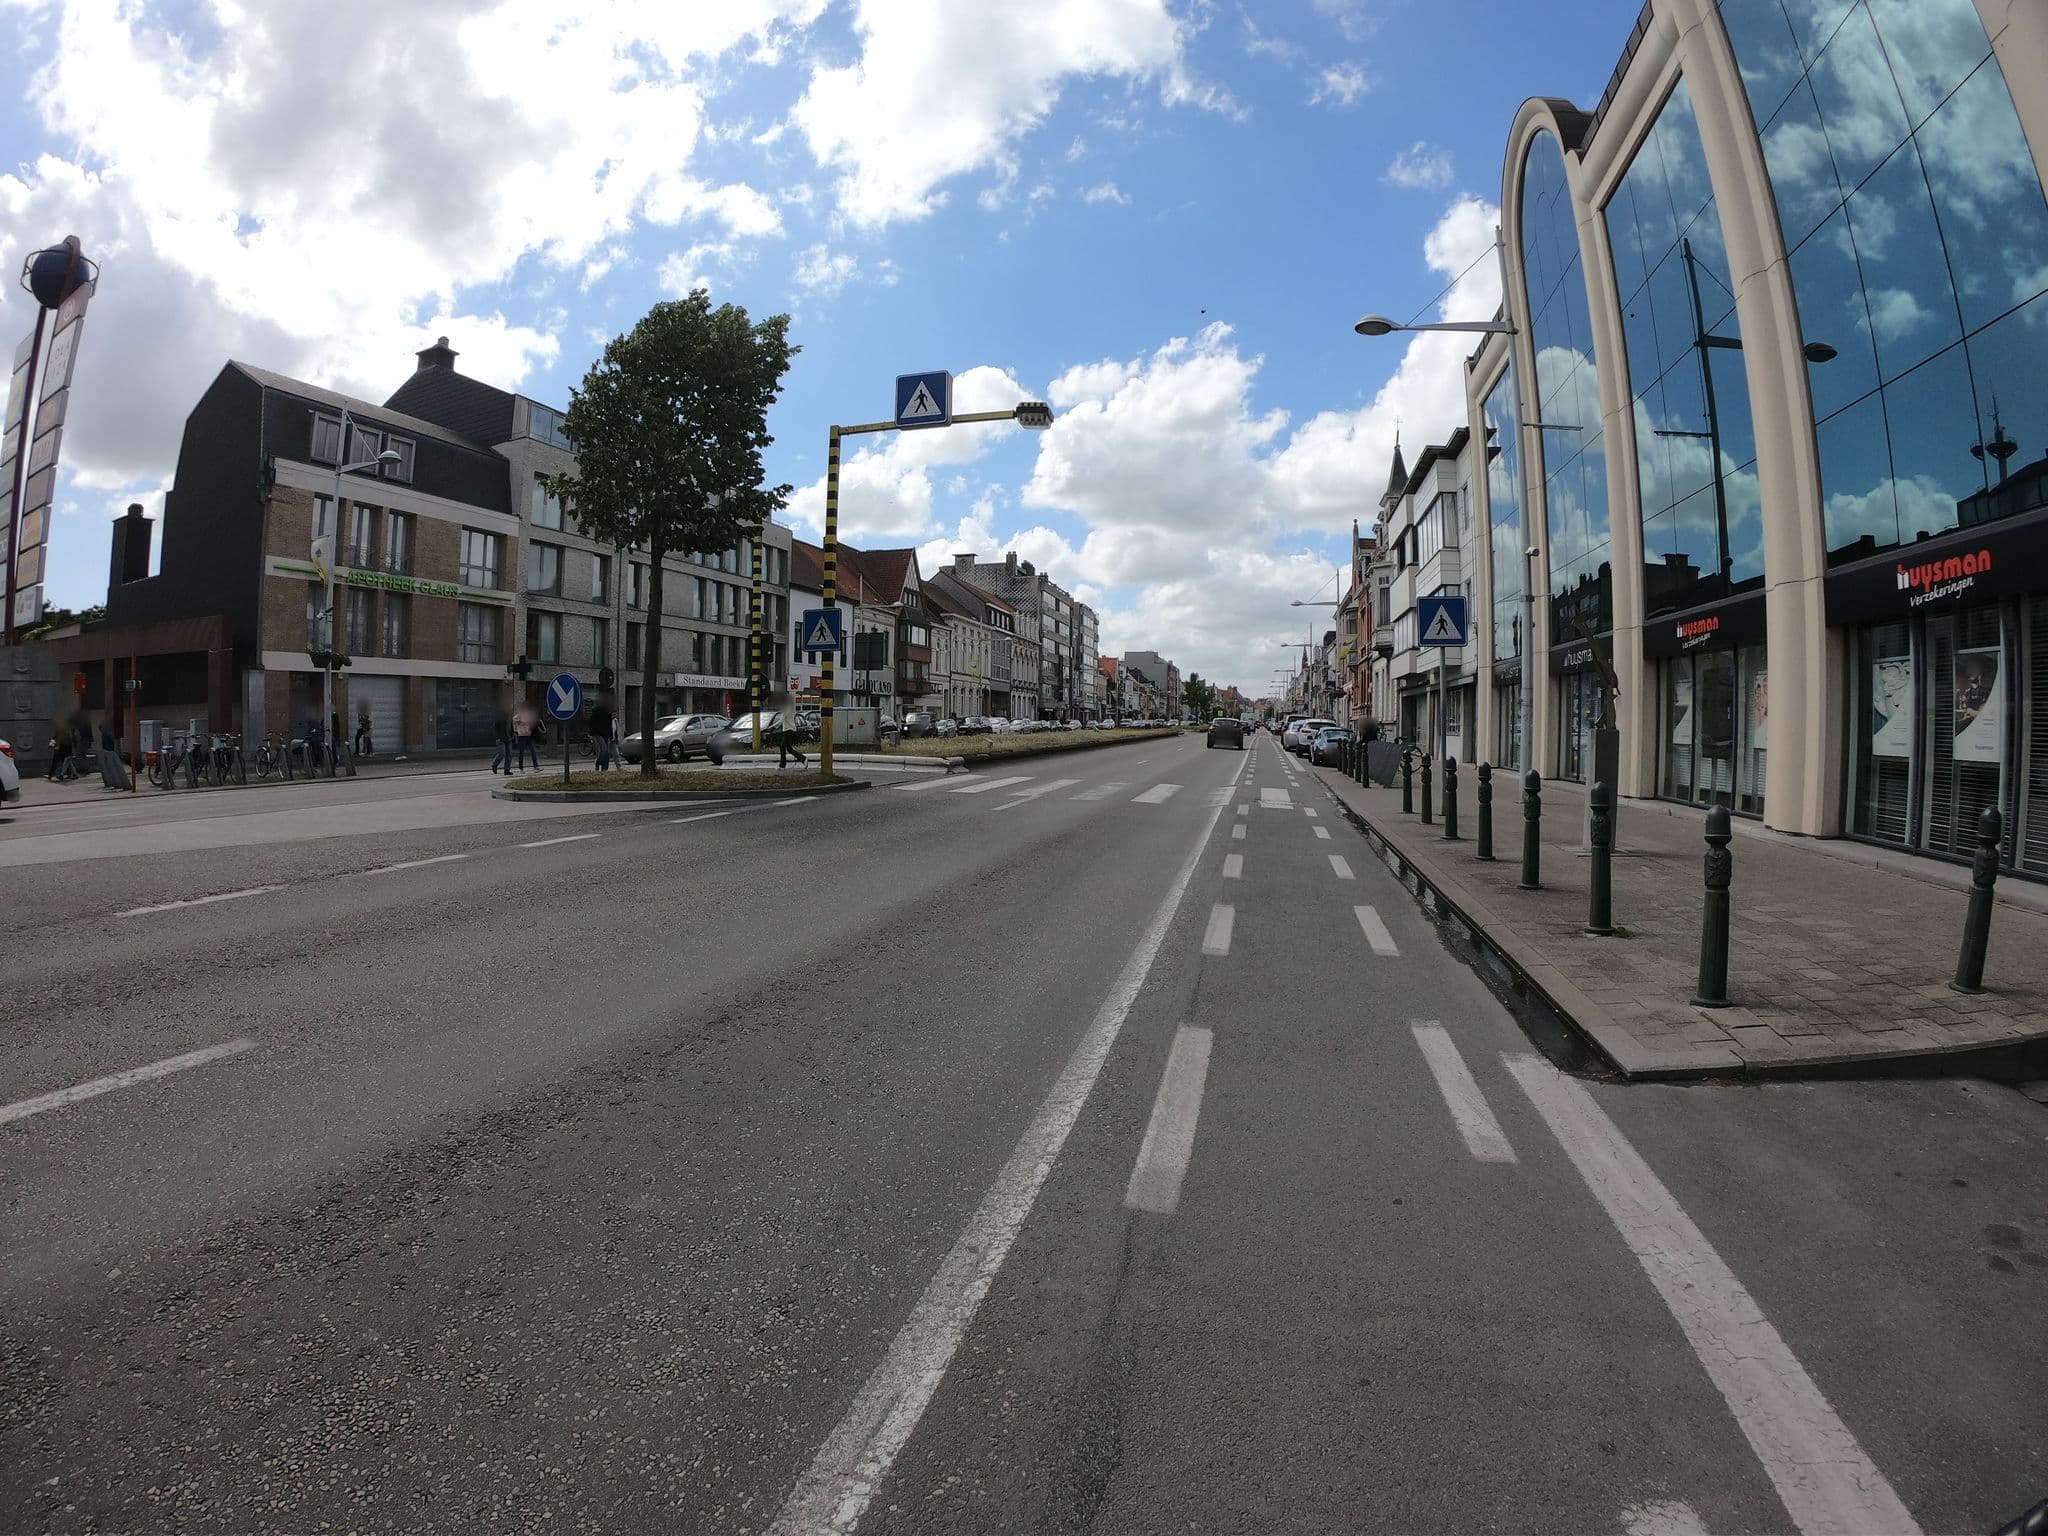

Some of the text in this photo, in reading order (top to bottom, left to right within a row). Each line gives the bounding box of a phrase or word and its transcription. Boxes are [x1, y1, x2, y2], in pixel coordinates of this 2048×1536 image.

[1896, 549, 1991, 592] huysman
[347, 571, 460, 599] APOTHEEK CLAUS
[1676, 615, 1719, 640] huysman
[683, 675, 722, 687] Standaard
